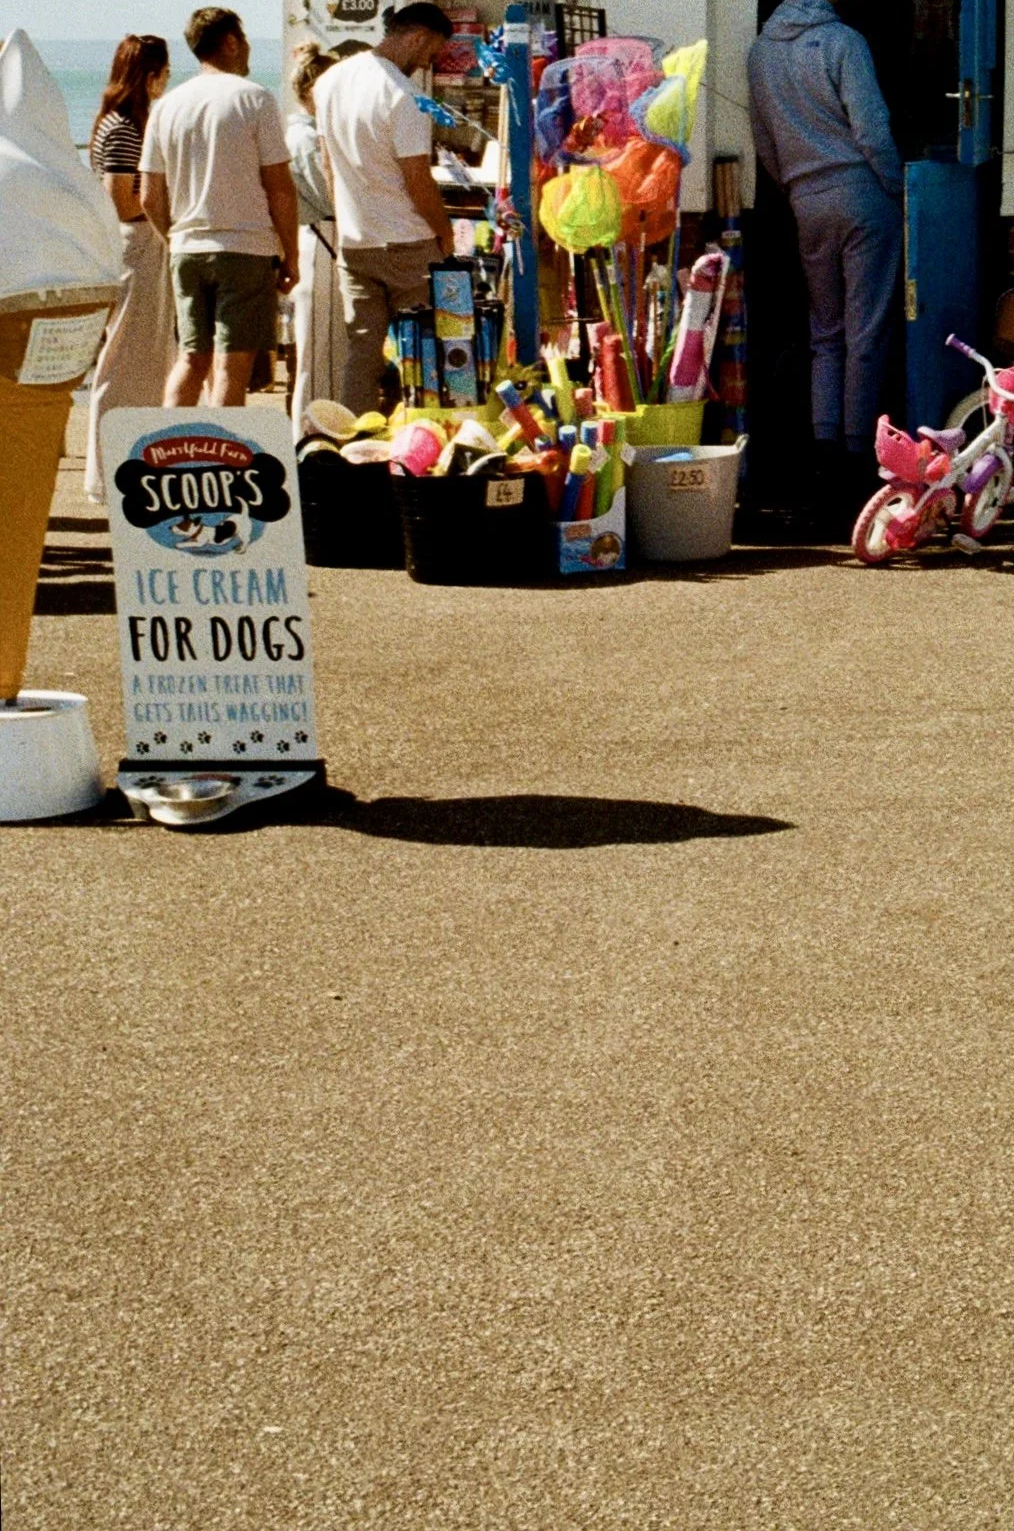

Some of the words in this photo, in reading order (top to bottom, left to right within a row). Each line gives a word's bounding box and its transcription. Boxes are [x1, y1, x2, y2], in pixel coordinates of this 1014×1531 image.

[341, 0, 374, 11] £3.00
[150, 442, 217, 464] Marshfield
[140, 469, 263, 512] SCOOP'S
[136, 569, 179, 605] ICE
[193, 569, 288, 606] CREAM
[129, 615, 197, 662] FOR
[210, 615, 305, 662] DOGS
[132, 674, 141, 695] A
[148, 674, 207, 695] FROZEN
[214, 674, 259, 694] TREAT
[267, 674, 305, 695] THAT
[133, 702, 172, 723] GETS
[179, 702, 220, 723] TAILS
[226, 701, 307, 723] WAGGING!
